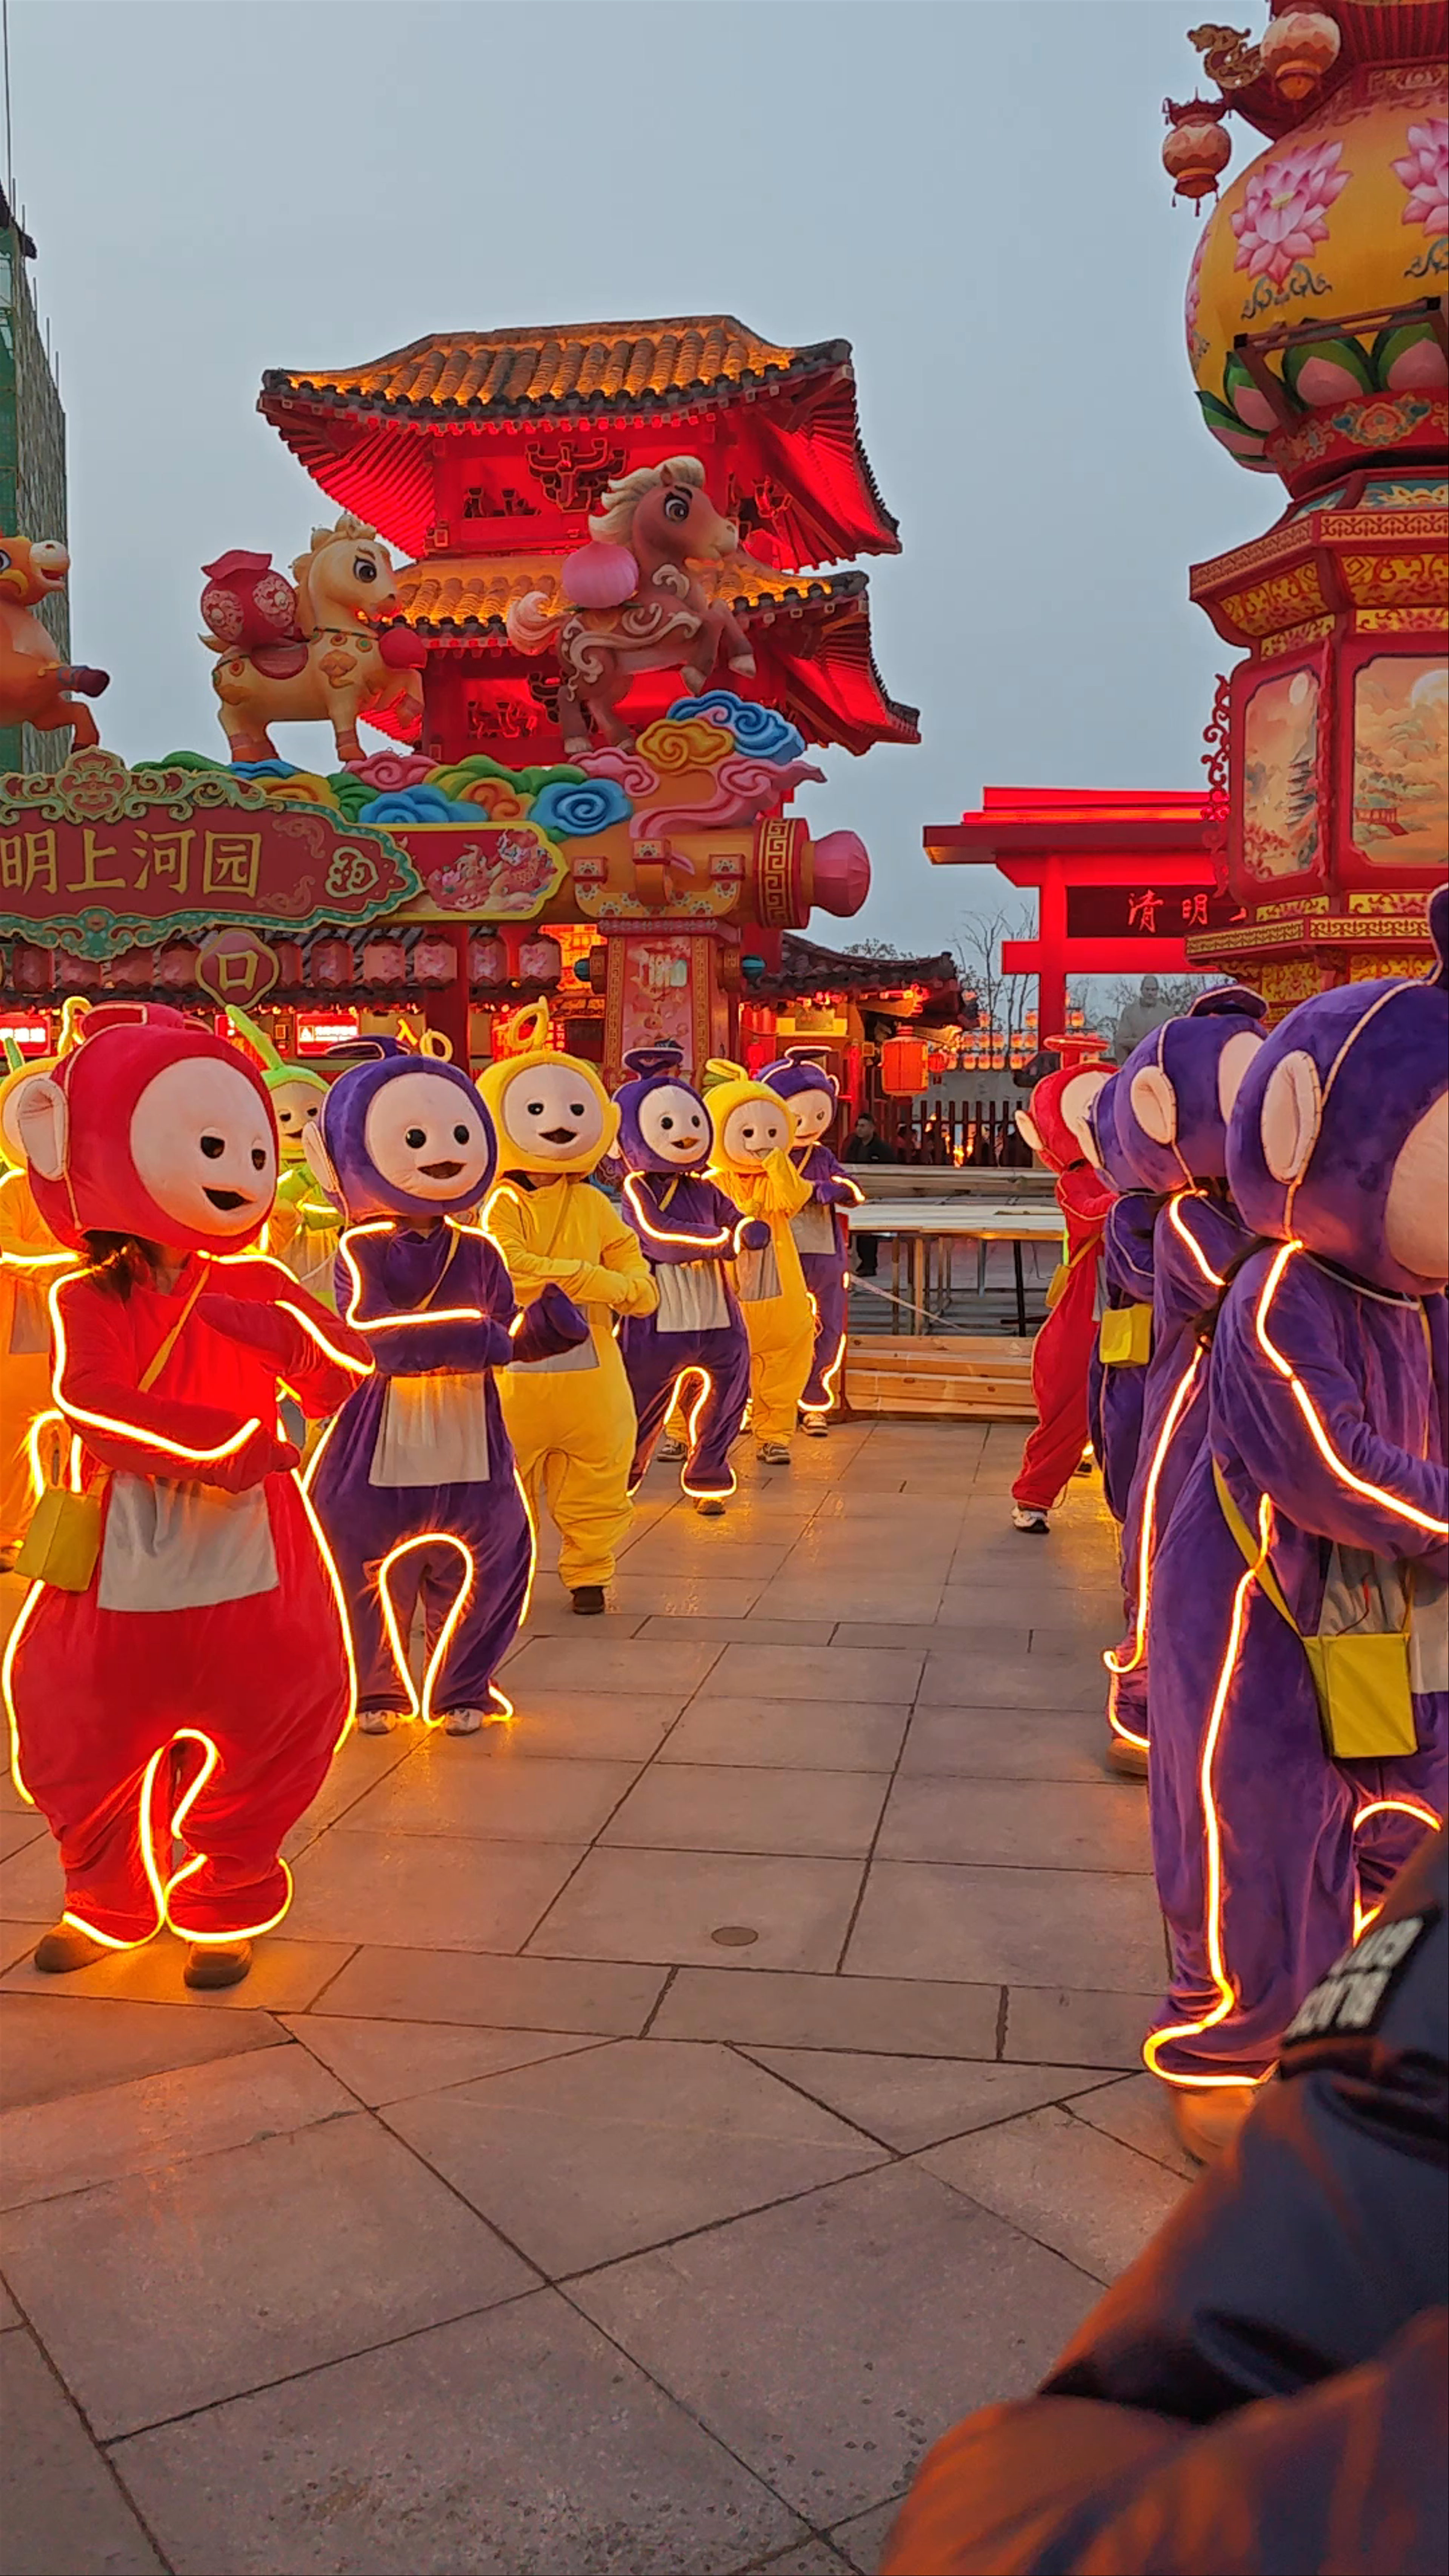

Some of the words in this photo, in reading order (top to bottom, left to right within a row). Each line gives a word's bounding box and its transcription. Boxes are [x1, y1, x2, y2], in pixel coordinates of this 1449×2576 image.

[0, 829, 261, 898] 明上河园
[217, 950, 258, 990] 口
